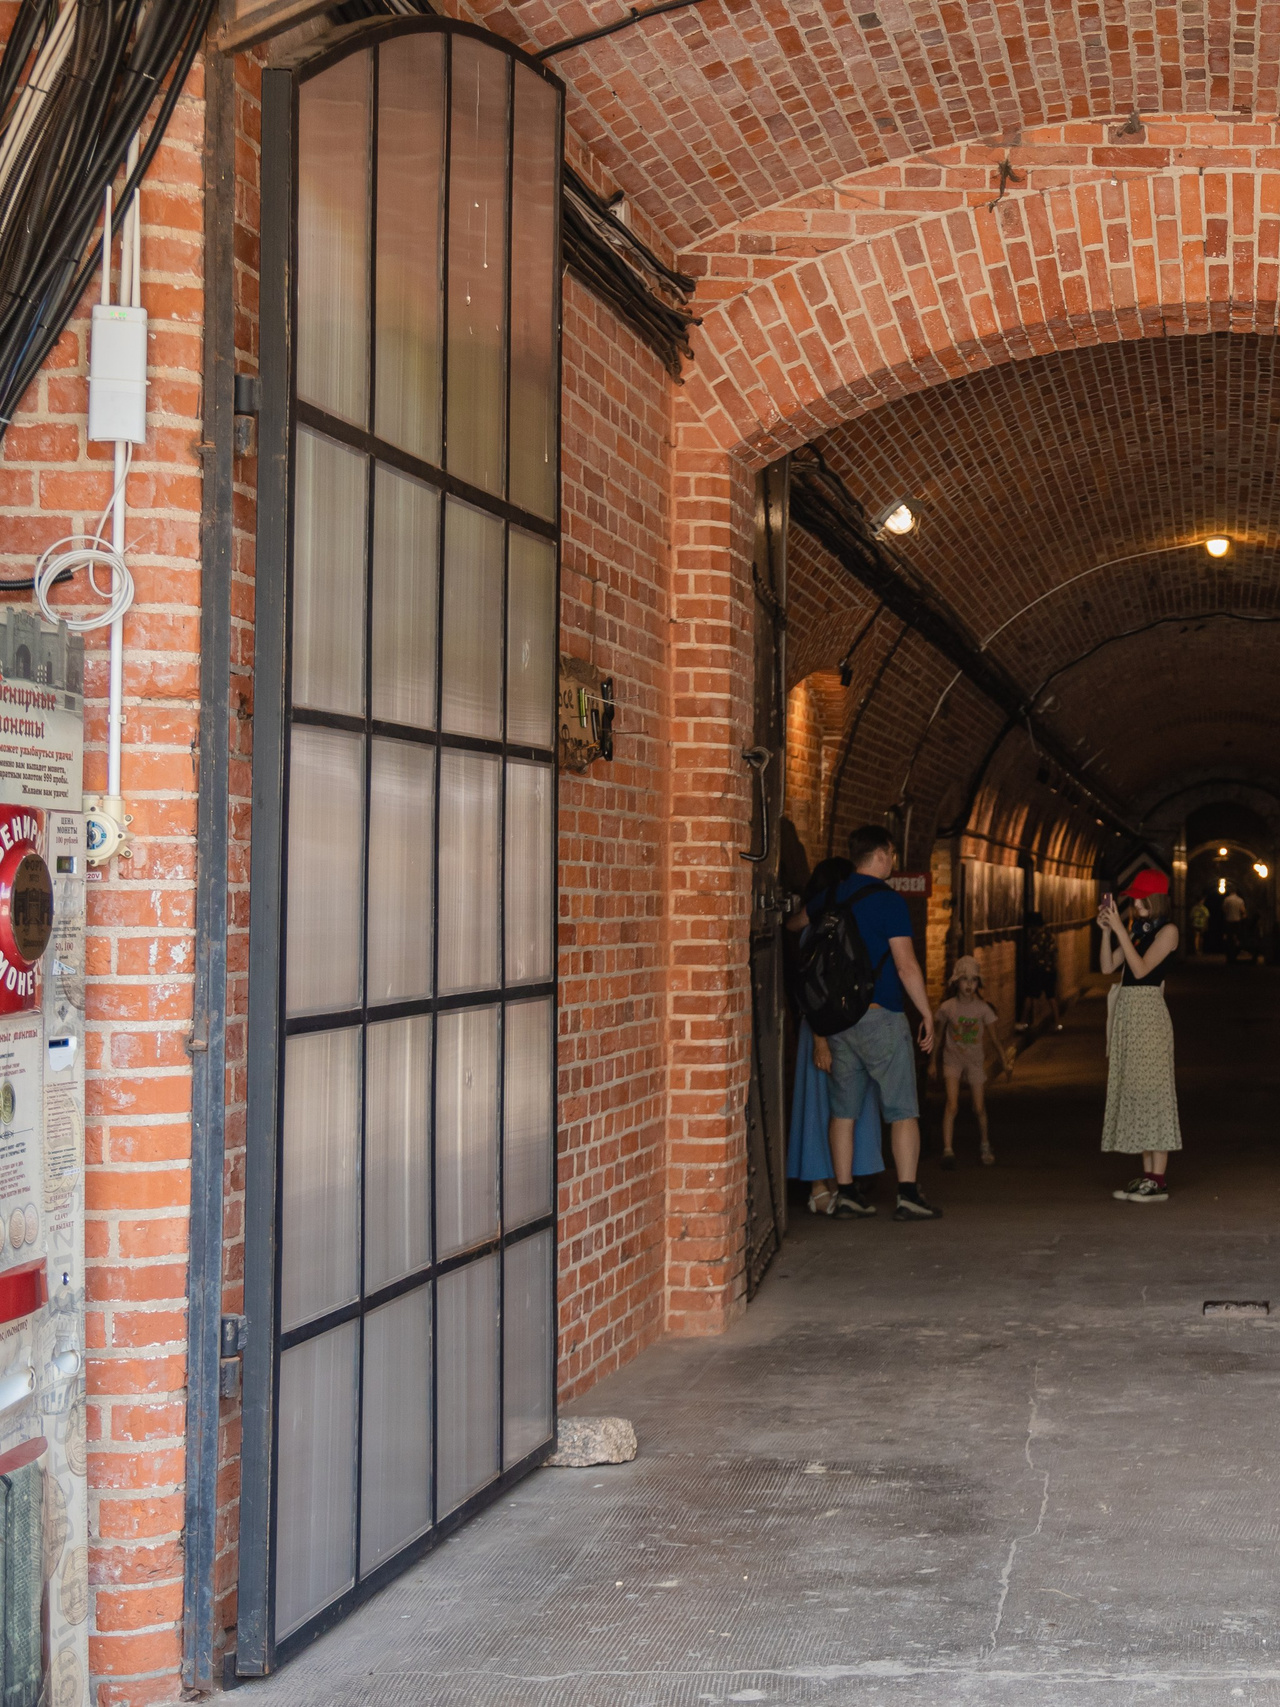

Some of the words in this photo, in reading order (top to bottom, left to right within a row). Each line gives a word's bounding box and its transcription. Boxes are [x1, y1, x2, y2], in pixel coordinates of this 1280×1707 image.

[20, 746, 54, 760] улыбнуться
[56, 750, 74, 762] удача!
[44, 773, 52, 783] 999
[22, 784, 42, 795] Желаем
[60, 816, 74, 825] ЦЕНА
[56, 826, 78, 834] МОНЕТЫ
